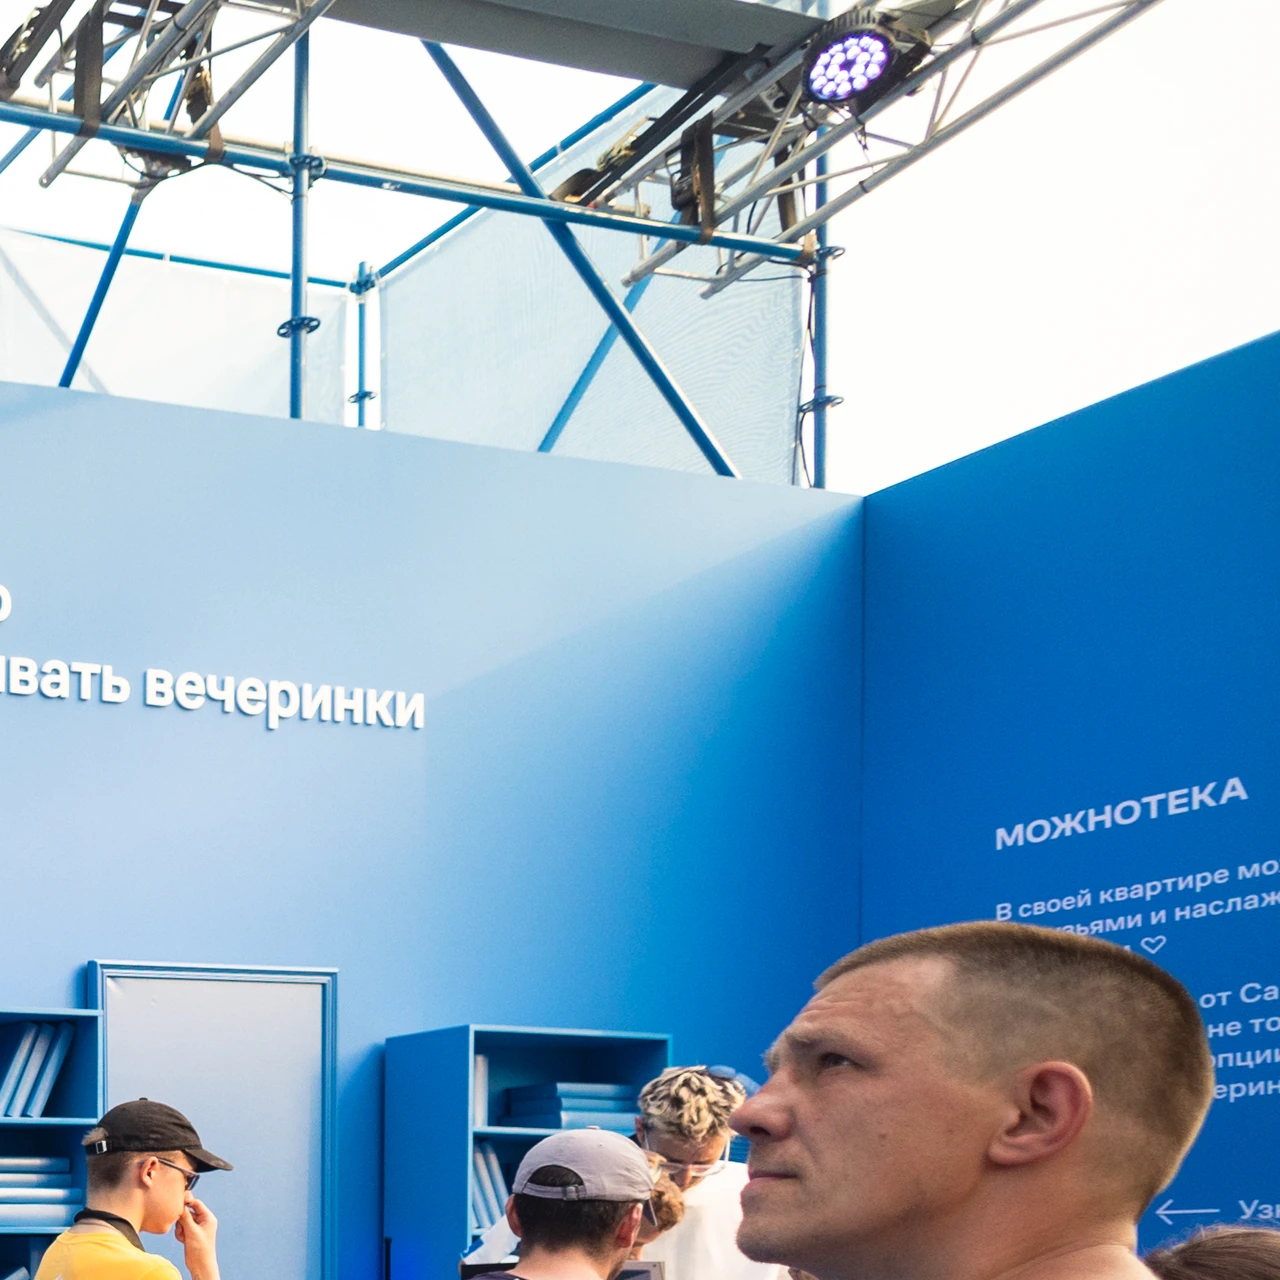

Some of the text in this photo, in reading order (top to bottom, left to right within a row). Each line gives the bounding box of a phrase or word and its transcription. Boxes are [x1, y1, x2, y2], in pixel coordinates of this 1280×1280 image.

[145, 667, 426, 731] вечеринки
[995, 776, 1248, 851] МОЖНОТЕКА
[995, 859, 1280, 921] В своей квартире мо
[1150, 909, 1167, 925] и
